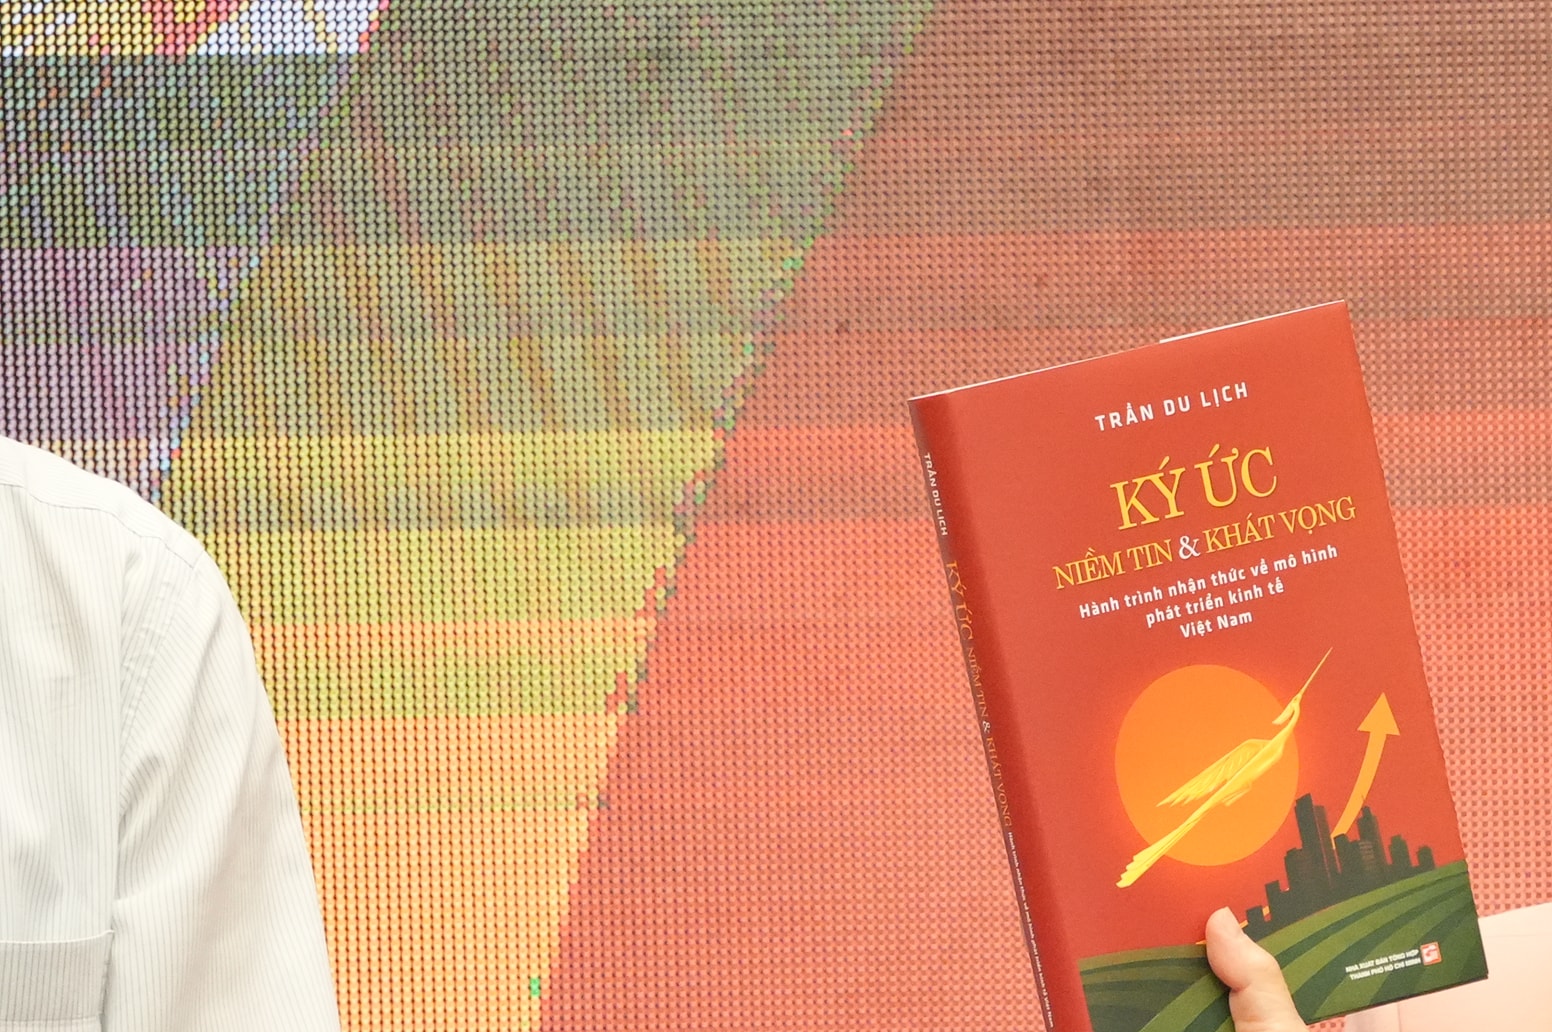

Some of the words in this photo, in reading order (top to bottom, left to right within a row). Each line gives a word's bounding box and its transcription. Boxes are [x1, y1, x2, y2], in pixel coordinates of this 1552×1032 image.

[1094, 402, 1154, 432] TRẦN
[1163, 395, 1191, 417] DU
[1200, 381, 1248, 408] LỊCH
[1110, 456, 1186, 530] KÝ
[1194, 443, 1278, 508] ỨC
[1053, 547, 1126, 589] NIỀM
[1126, 539, 1174, 572] TIN
[1178, 535, 1201, 560] &
[1202, 512, 1277, 553] KHÁT
[1278, 495, 1357, 535] VỌNG
[1079, 597, 1120, 619] Hành
[1124, 586, 1164, 608] trình
[1168, 577, 1207, 599] nhận
[1211, 567, 1246, 587] thức
[1250, 558, 1269, 577] về
[1273, 552, 1297, 572] mô
[1302, 544, 1338, 566] hình
[1146, 605, 1182, 628] phát
[1185, 593, 1224, 615] triển
[1228, 583, 1263, 605] kinh
[1268, 576, 1285, 595] tế
[1180, 617, 1213, 639] Việt
[1217, 610, 1253, 630] Nam
